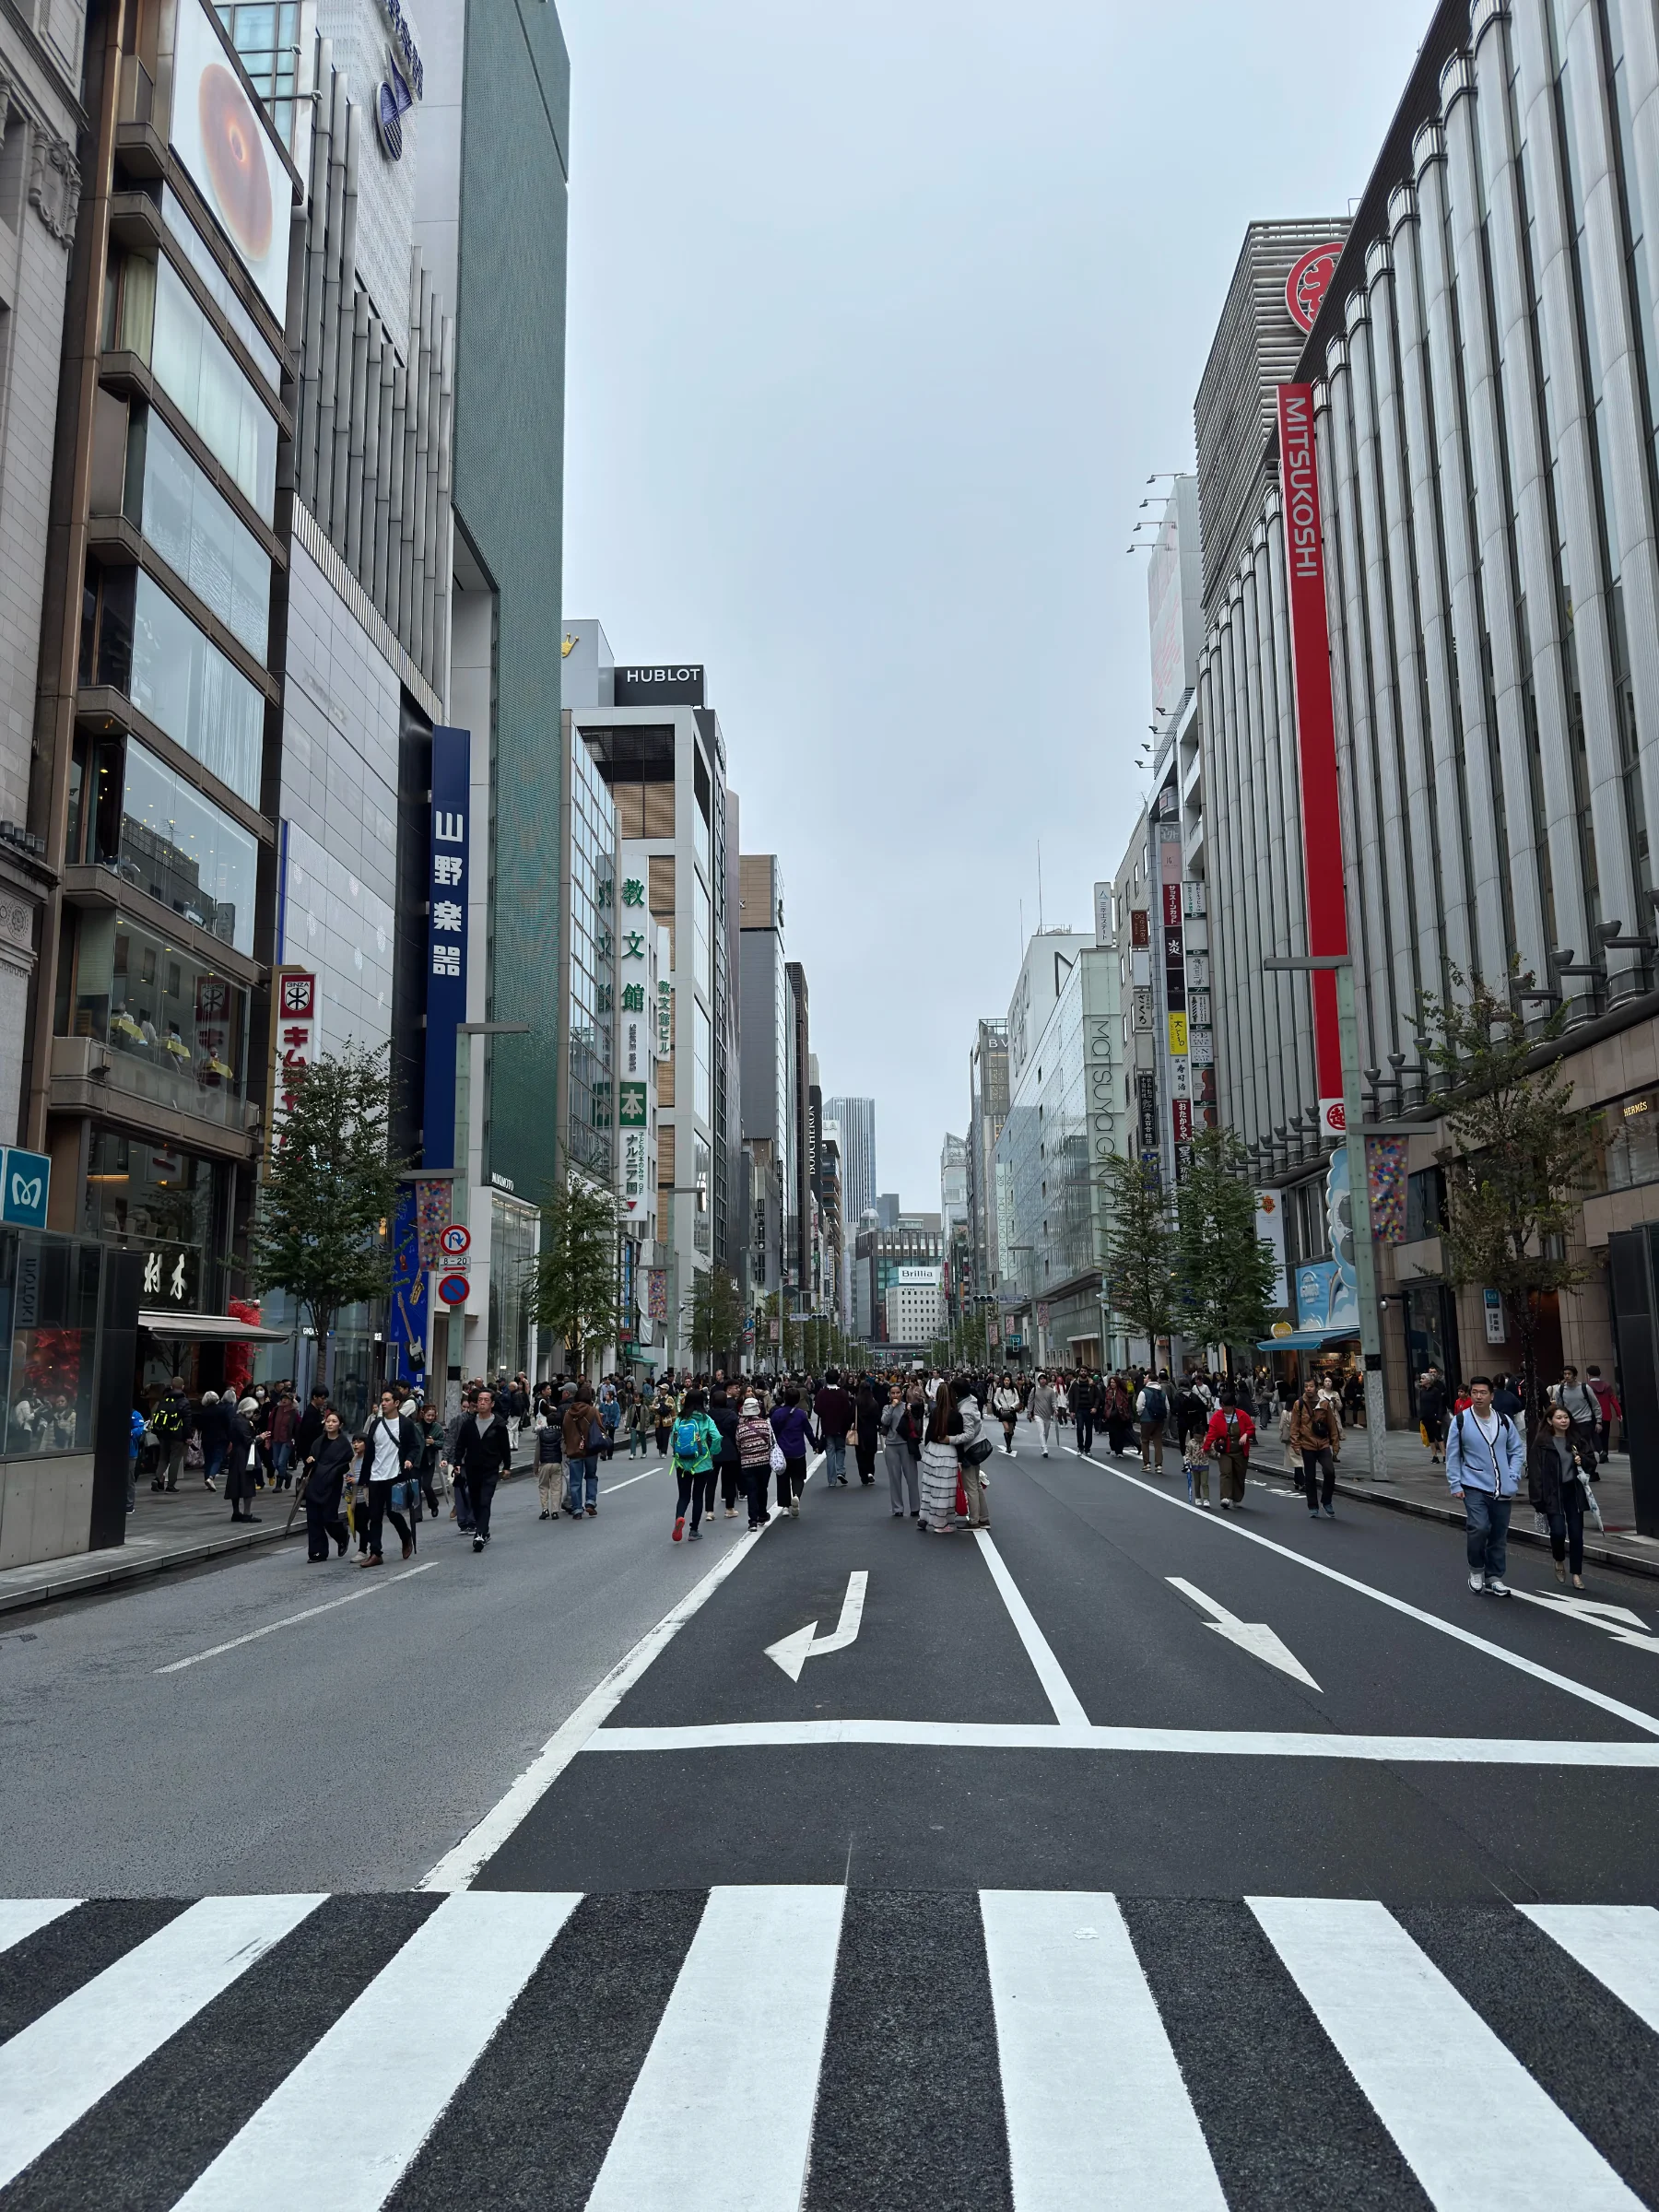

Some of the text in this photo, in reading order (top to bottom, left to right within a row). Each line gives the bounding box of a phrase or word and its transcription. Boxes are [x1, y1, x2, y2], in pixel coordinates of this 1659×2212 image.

[1285, 397, 1318, 577] MITSUKOSHI
[627, 668, 700, 683] HUBLOT
[432, 810, 464, 977] 山野楽器
[1169, 885, 1177, 924] サッスーンカット
[621, 877, 645, 1013] 教文館
[1168, 939, 1182, 956] 炎
[658, 980, 671, 1054] 教文館ビル
[1137, 994, 1147, 1025] ざくろ
[629, 1023, 638, 1051] SINCE
[621, 1088, 644, 1120] 本
[1179, 1102, 1188, 1139] おたからや
[491, 1171, 514, 1192] MIKIMOTO
